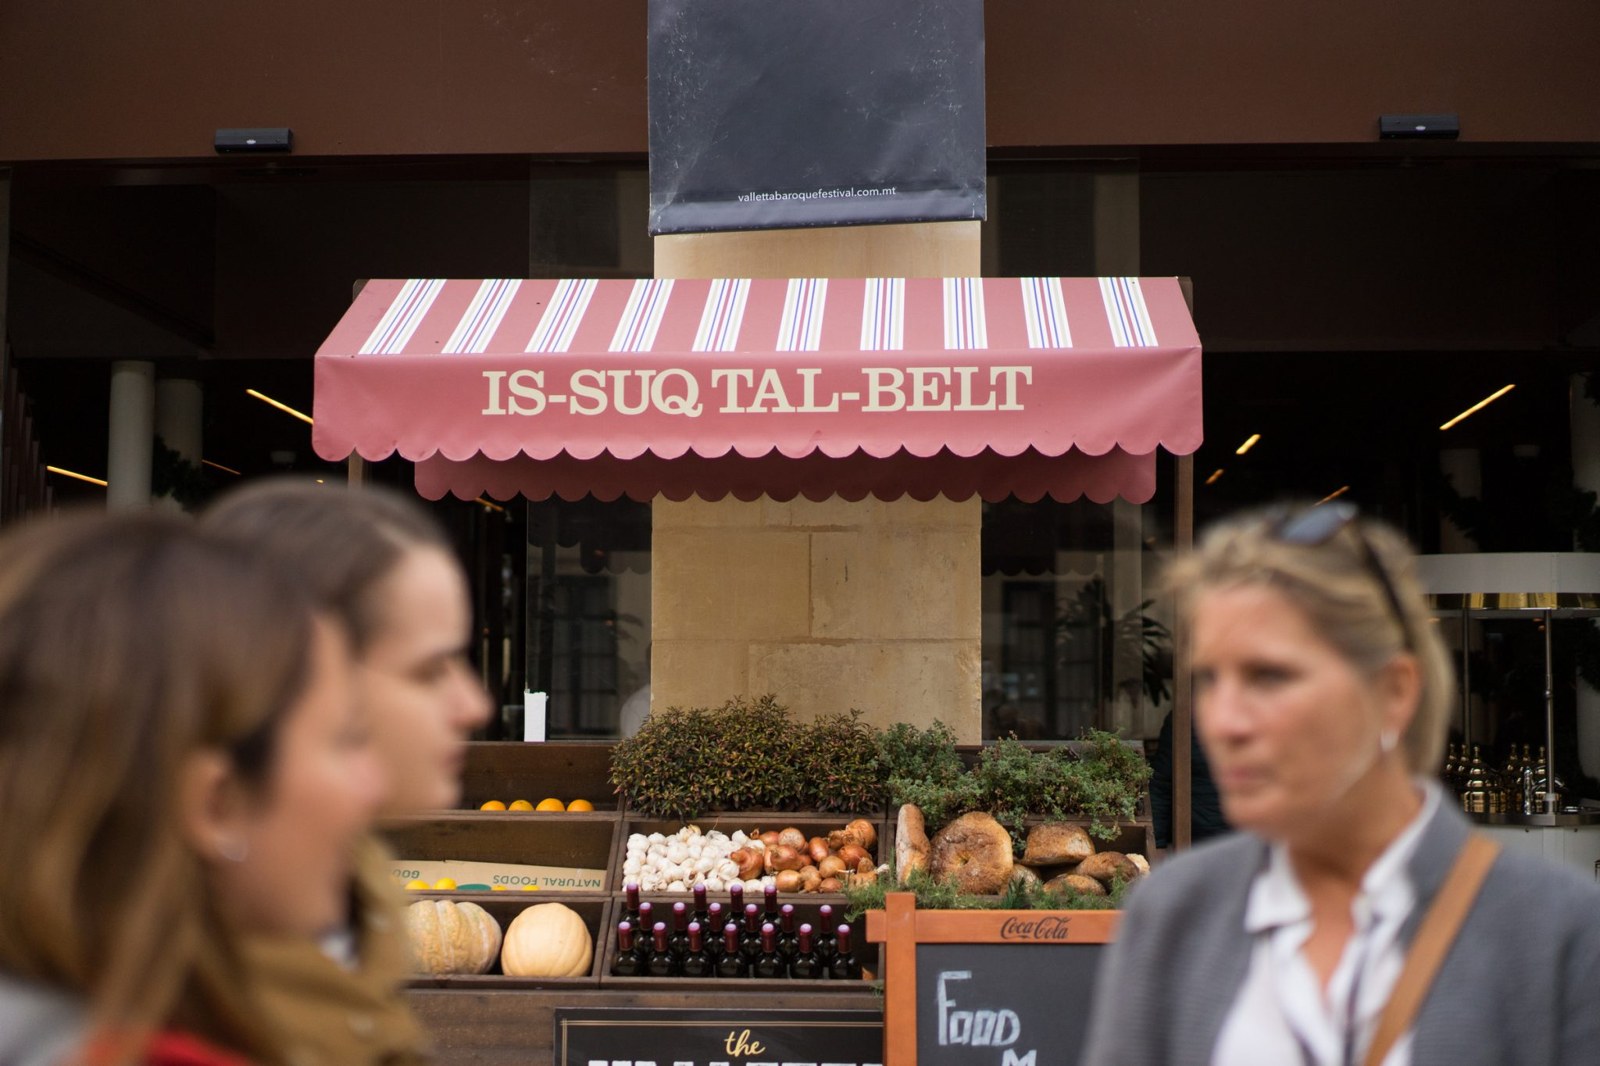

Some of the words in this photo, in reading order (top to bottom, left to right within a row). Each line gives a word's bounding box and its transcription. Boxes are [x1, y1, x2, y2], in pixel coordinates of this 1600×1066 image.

[738, 186, 897, 202] vallettabaroquefestival.com.mt
[482, 368, 703, 417] IS-SUQ
[711, 366, 1033, 413] TAL-BELT
[493, 874, 537, 886] FOODS
[542, 877, 601, 888] NATURAL
[1000, 916, 1072, 940] Coca-Cola
[724, 1029, 766, 1057] the
